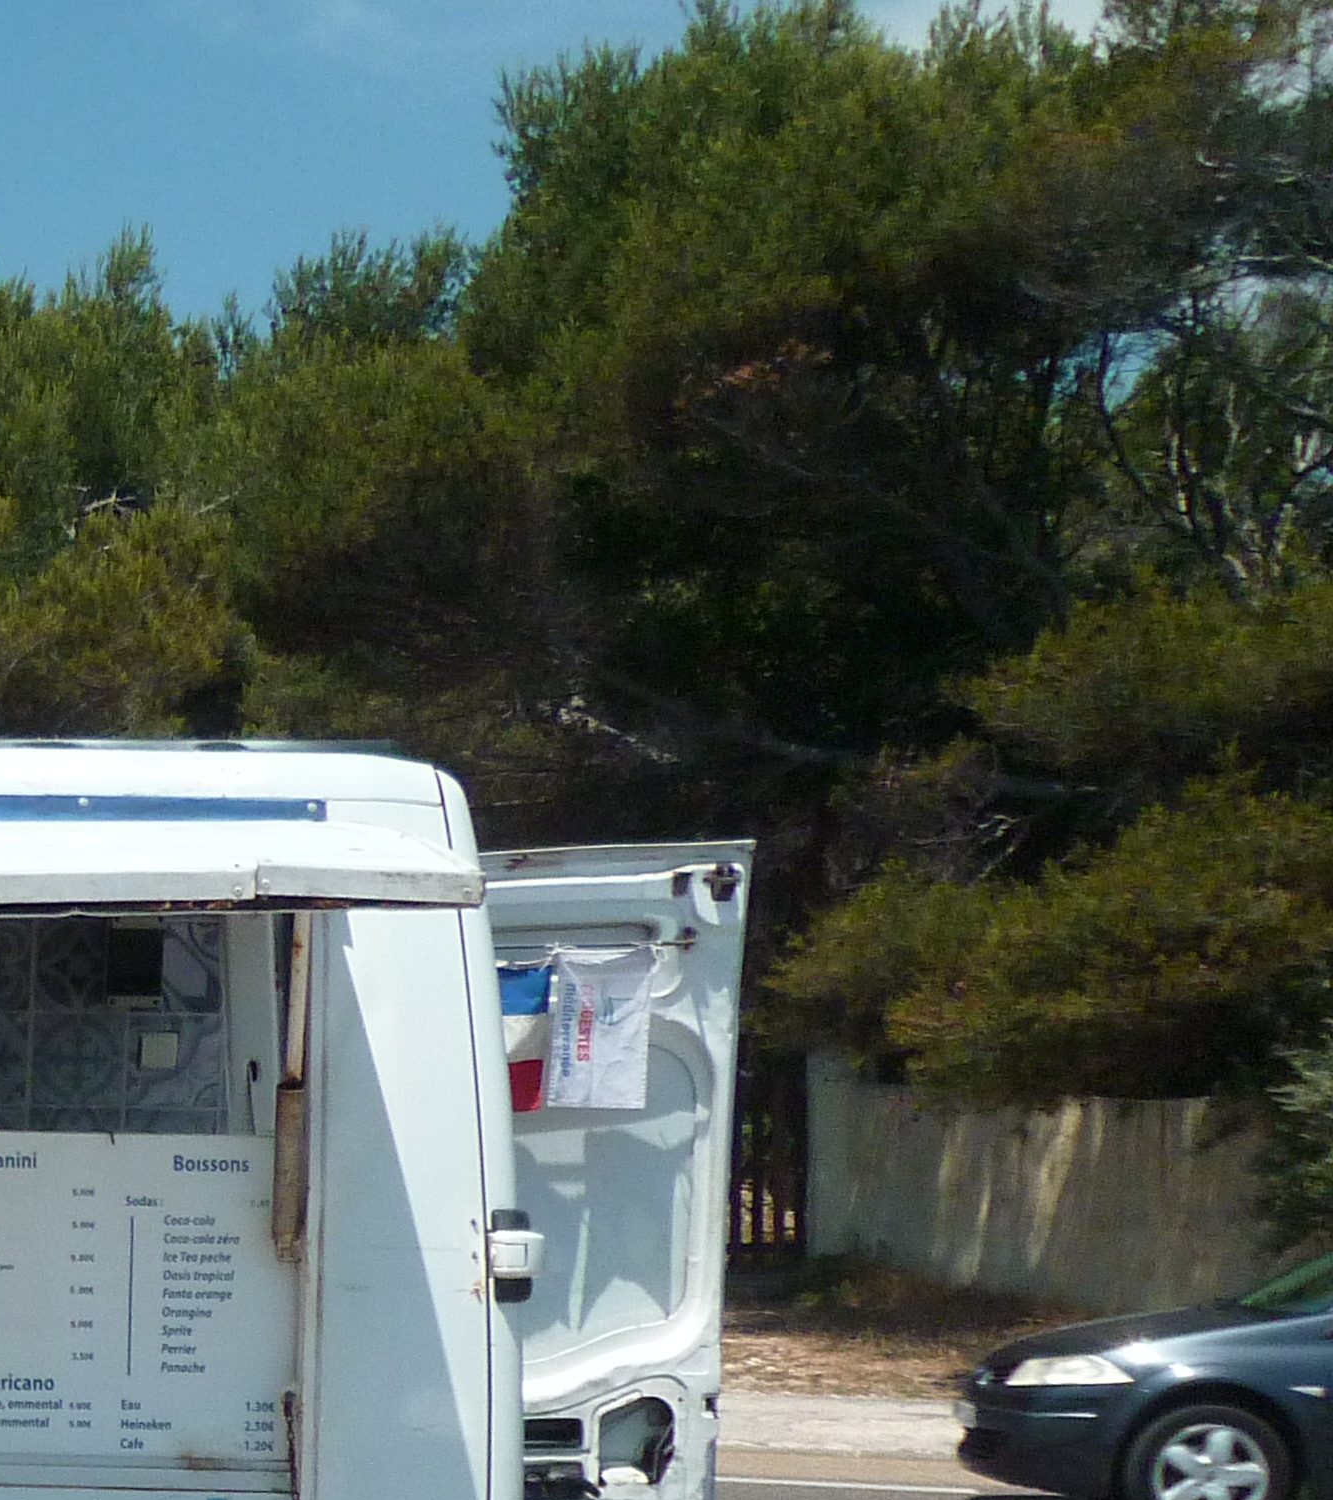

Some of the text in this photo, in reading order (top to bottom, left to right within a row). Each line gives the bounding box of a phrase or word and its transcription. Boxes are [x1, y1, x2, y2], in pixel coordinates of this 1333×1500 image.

[172, 1154, 250, 1172] Boissons
[163, 1214, 216, 1226] Coca-cola
[163, 1233, 215, 1245] Coca-cola
[163, 1252, 179, 1263] Ice
[181, 1252, 198, 1263] Tea
[163, 1269, 235, 1284] Oasis tropical
[162, 1288, 233, 1302] Fanta orange
[161, 1306, 212, 1320] Orangina
[161, 1325, 193, 1338] Sprite
[160, 1343, 198, 1355] Perrier
[7, 1397, 64, 1410] emmental
[120, 1399, 276, 1413] Eau 1.30€
[120, 1418, 172, 1431] Heineken
[244, 1440, 275, 1451] 1.20€
